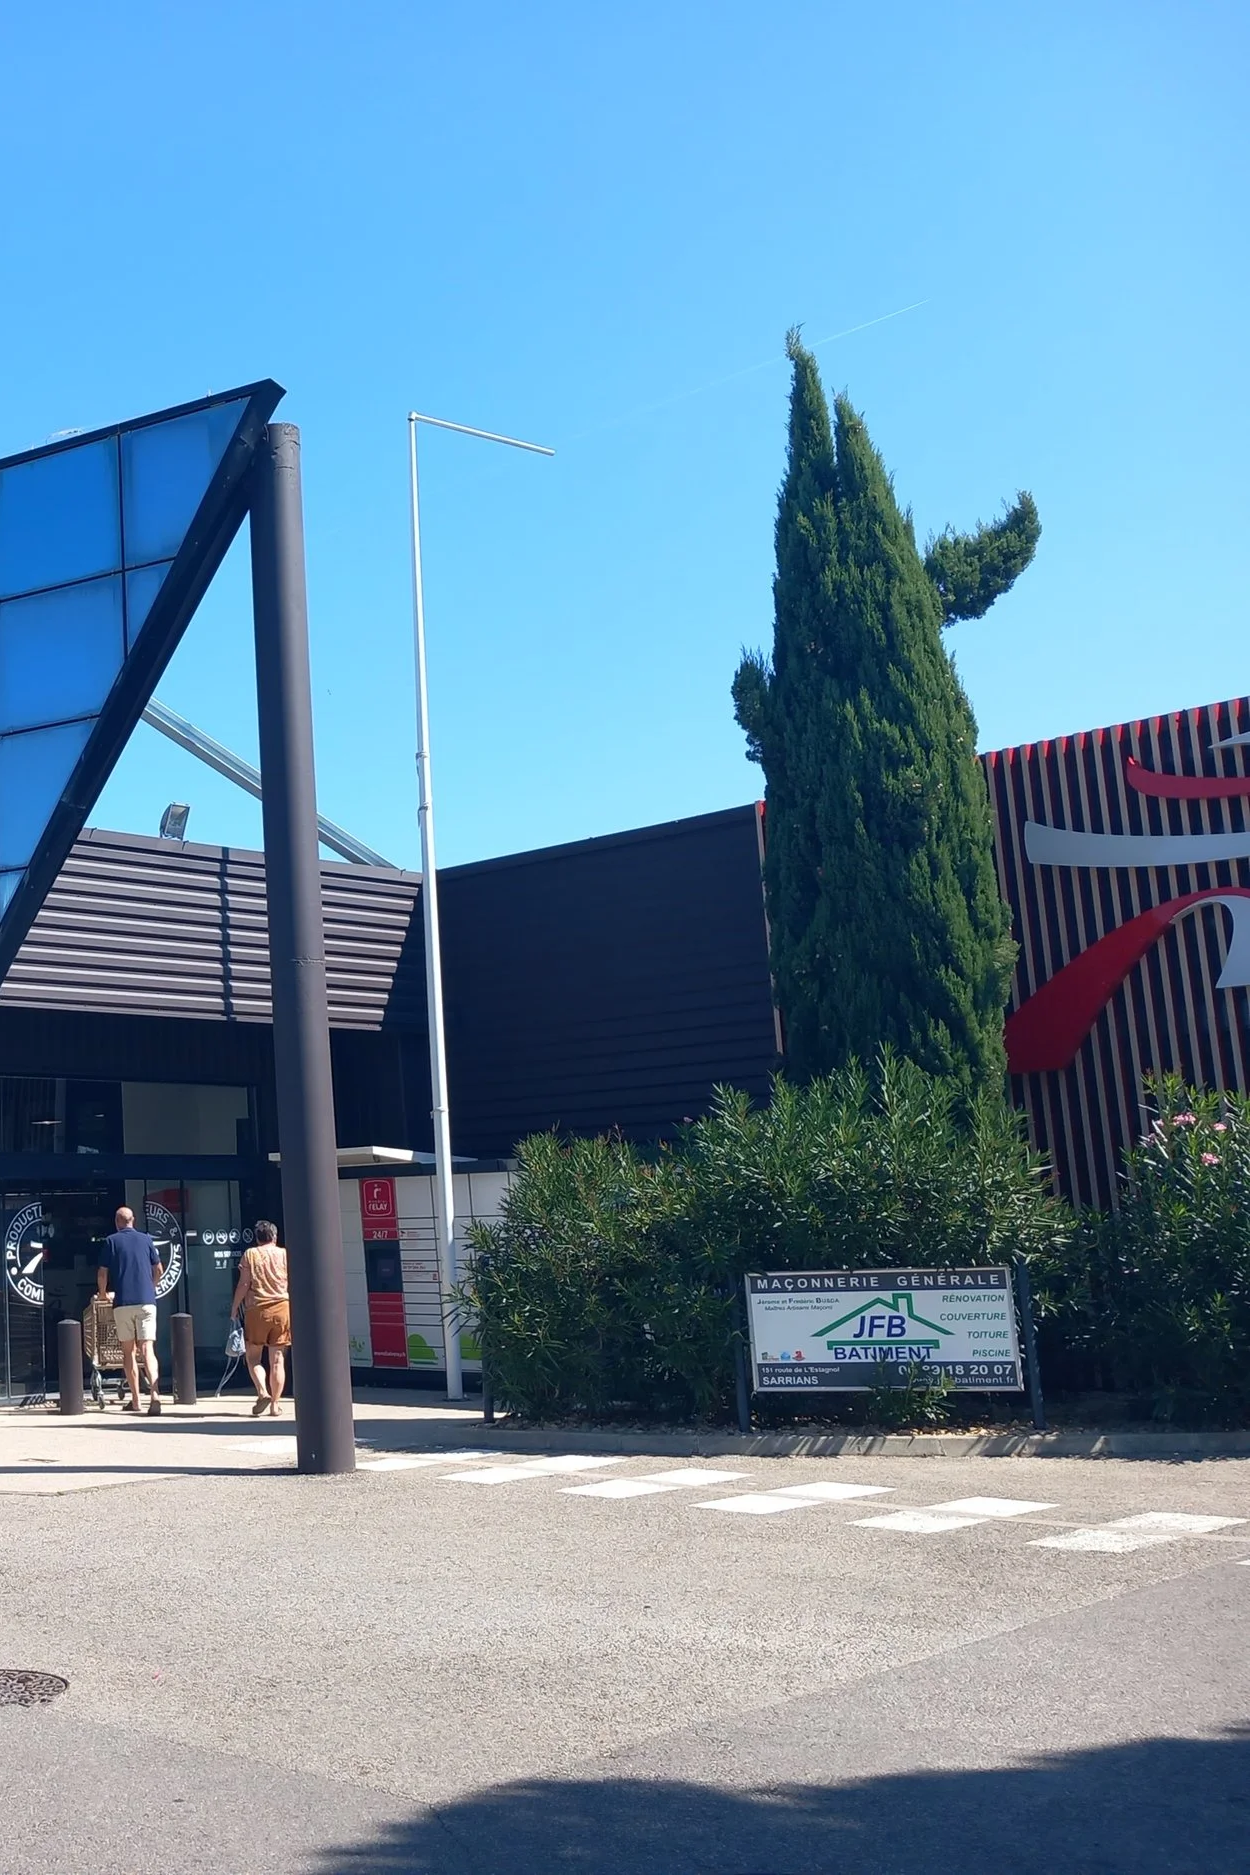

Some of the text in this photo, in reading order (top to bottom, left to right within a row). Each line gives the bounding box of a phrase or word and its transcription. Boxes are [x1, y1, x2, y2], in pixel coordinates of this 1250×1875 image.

[756, 1273, 1001, 1291] MAÇONNERIE GÉNÉRALE
[939, 1312, 1007, 1321] COUVERTURE
[852, 1315, 907, 1339] JFB
[967, 1330, 1009, 1339] TOITURE
[834, 1346, 934, 1360] BATIMENT
[972, 1349, 1011, 1357] PISCINE
[946, 1364, 965, 1375] 18
[969, 1364, 989, 1375] 20
[993, 1364, 1012, 1375] 07
[762, 1376, 819, 1385] SARRIANS
